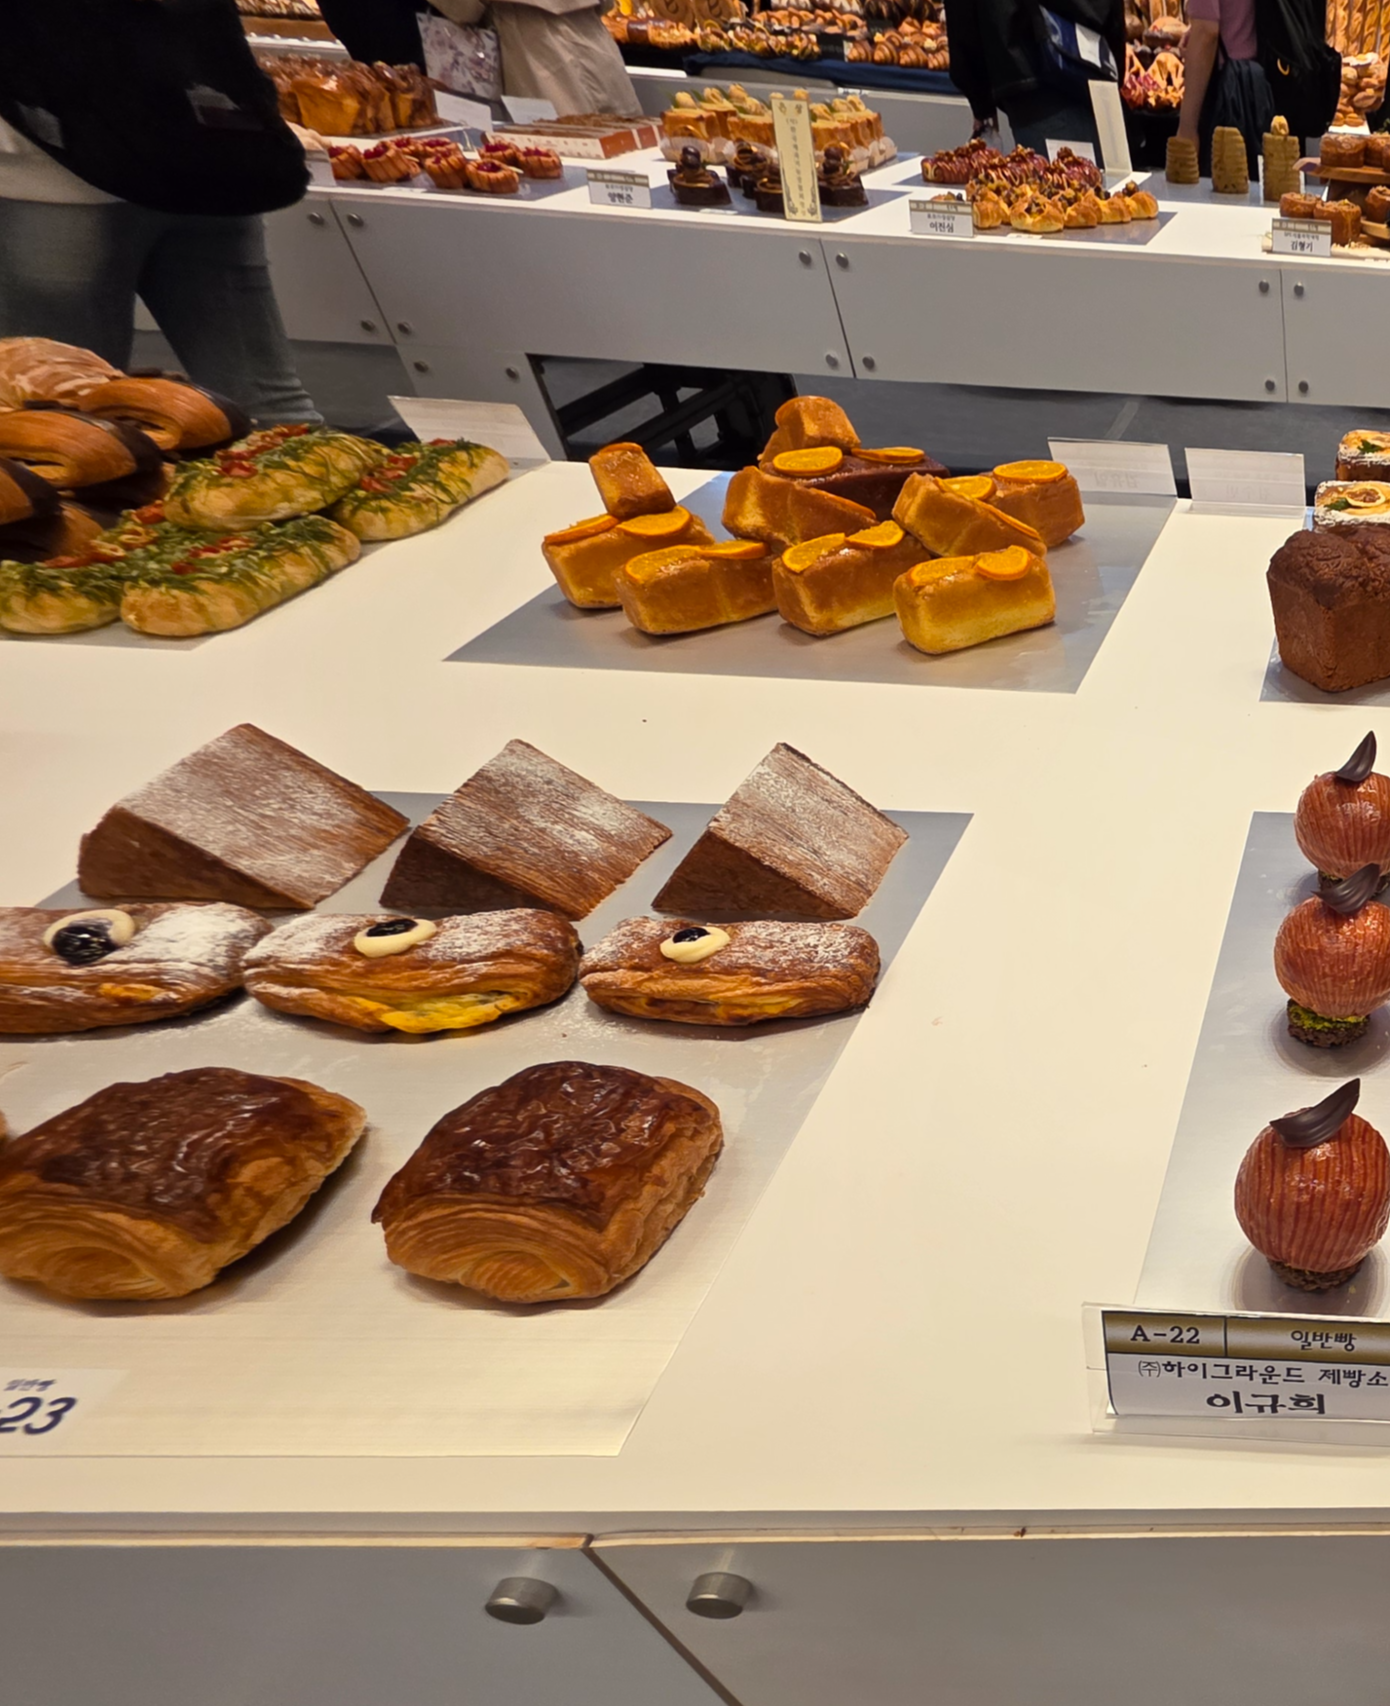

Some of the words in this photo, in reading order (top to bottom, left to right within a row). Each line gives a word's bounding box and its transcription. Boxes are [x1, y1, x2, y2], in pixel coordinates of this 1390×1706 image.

[1130, 1324, 1200, 1344] A-22
[1291, 1330, 1357, 1352] 일반빵
[1318, 1368, 1389, 1388] 제빵소
[1206, 1390, 1326, 1415] 이규희
[0, 1396, 78, 1435] 23
